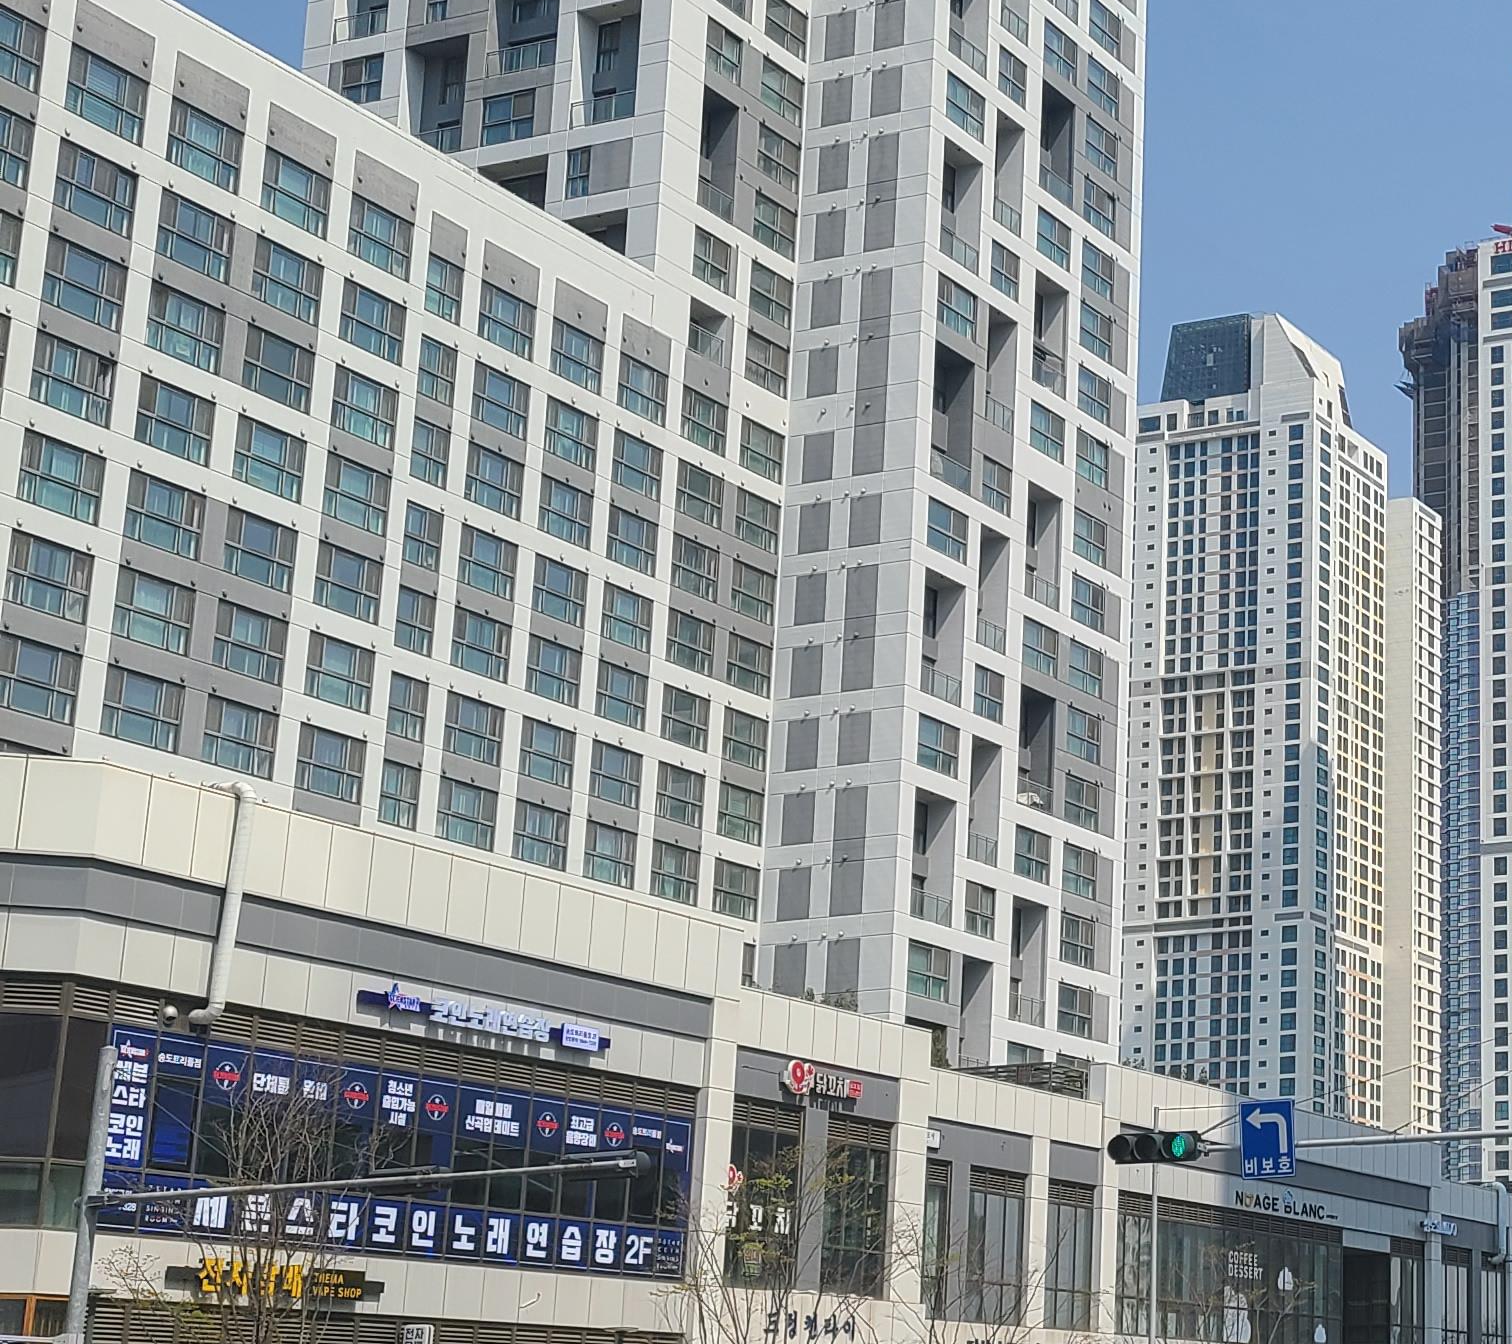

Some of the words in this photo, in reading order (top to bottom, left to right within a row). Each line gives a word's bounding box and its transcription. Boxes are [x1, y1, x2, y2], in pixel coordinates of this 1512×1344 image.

[430, 999, 550, 1043] 코인노래연습장
[387, 1079, 413, 1097] 청소년
[815, 1073, 848, 1099] 닭꼬치
[112, 1085, 146, 1109] 스타
[381, 1094, 416, 1113] 출입가능
[108, 1112, 143, 1137] 코인
[389, 1111, 406, 1127] 시설
[570, 1115, 595, 1132] 최고급
[565, 1130, 597, 1147] 음향장비
[104, 1138, 141, 1161] 노래
[1244, 1157, 1293, 1176] 비보호
[1284, 1200, 1326, 1220] BLANC
[626, 1236, 653, 1265] 2F
[1228, 1250, 1258, 1267] COFFEE
[1228, 1264, 1264, 1281] DESSERT
[312, 1285, 336, 1298] VAPE
[338, 1287, 362, 1299] SHOP
[405, 1327, 424, 1341] 전자
